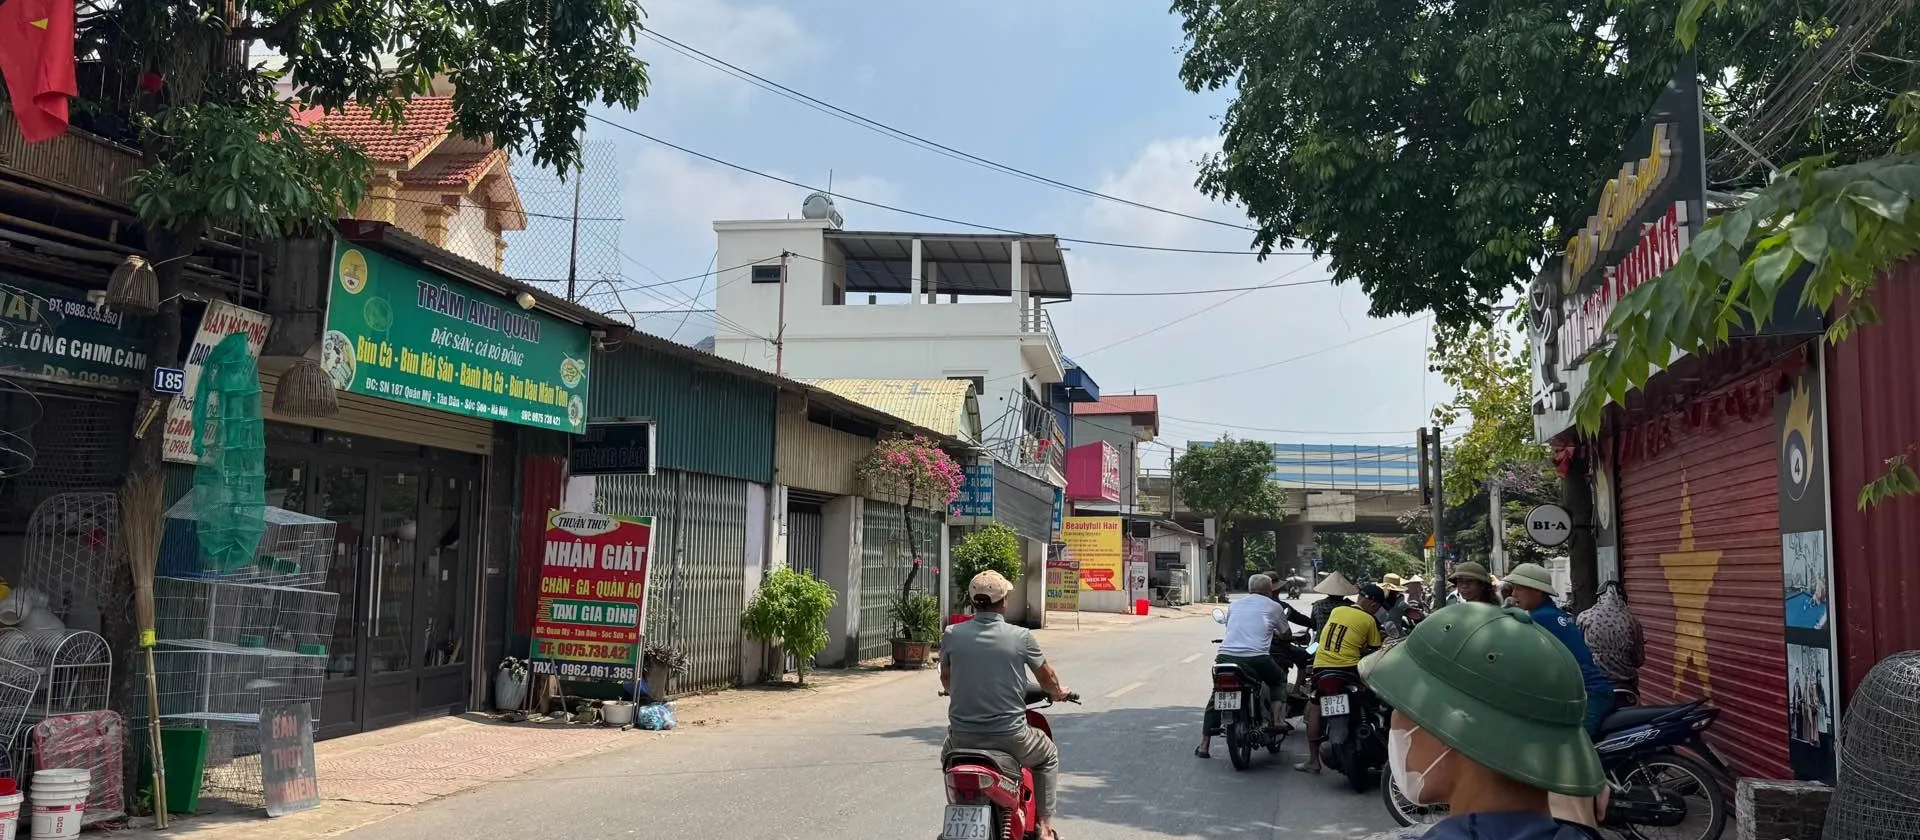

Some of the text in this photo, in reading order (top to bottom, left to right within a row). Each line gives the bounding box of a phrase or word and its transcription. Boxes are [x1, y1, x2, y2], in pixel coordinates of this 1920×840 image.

[417, 280, 541, 344] TRÂM ANH QUÁN
[247, 322, 267, 346] ONG
[357, 335, 378, 365] Bún
[379, 341, 393, 369] Cá
[400, 346, 419, 375] Bún
[420, 351, 436, 379] Hải
[437, 356, 454, 383] Sản
[460, 362, 481, 388] Bánh
[494, 371, 504, 394] Cá
[509, 374, 524, 399] Bún
[157, 371, 183, 390] 185
[379, 381, 390, 394] SN
[391, 384, 404, 396] 187
[1793, 459, 1802, 477] 4
[1103, 521, 1119, 530] Hair
[1533, 520, 1568, 531] BI-A
[544, 538, 647, 576] NHẬN GIẶT
[576, 579, 590, 596] GA
[627, 579, 642, 599] ÁO
[552, 603, 638, 624] TAXI GIA ĐÌNH
[558, 643, 630, 660] 0975.738.421
[561, 663, 633, 680] 0962.061.385
[945, 823, 987, 839] 217.33
